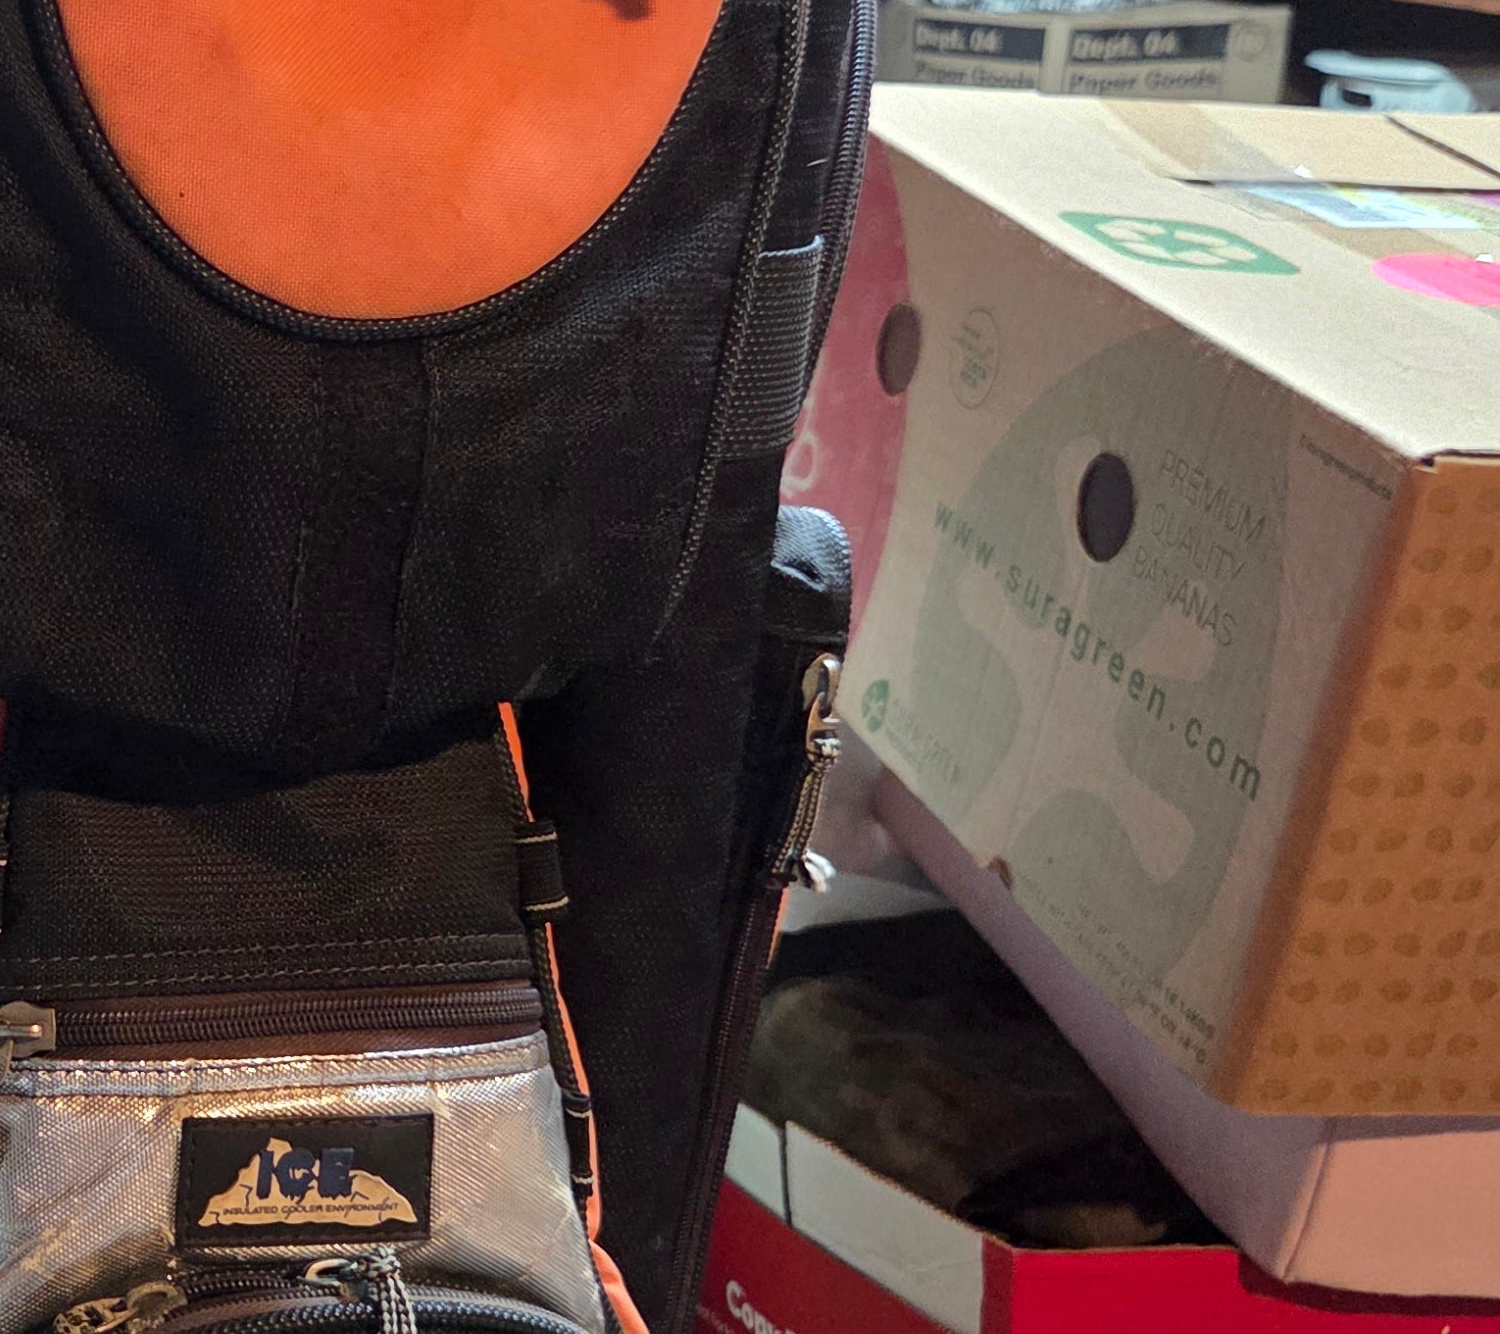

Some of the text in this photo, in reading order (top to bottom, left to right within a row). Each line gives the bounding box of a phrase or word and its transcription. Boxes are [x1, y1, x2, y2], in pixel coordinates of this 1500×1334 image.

[933, 501, 1263, 802] www.suragreen.com
[256, 1145, 354, 1200] ICE
[222, 1202, 399, 1216] INSULATED COOLER ENVIRONMENT
